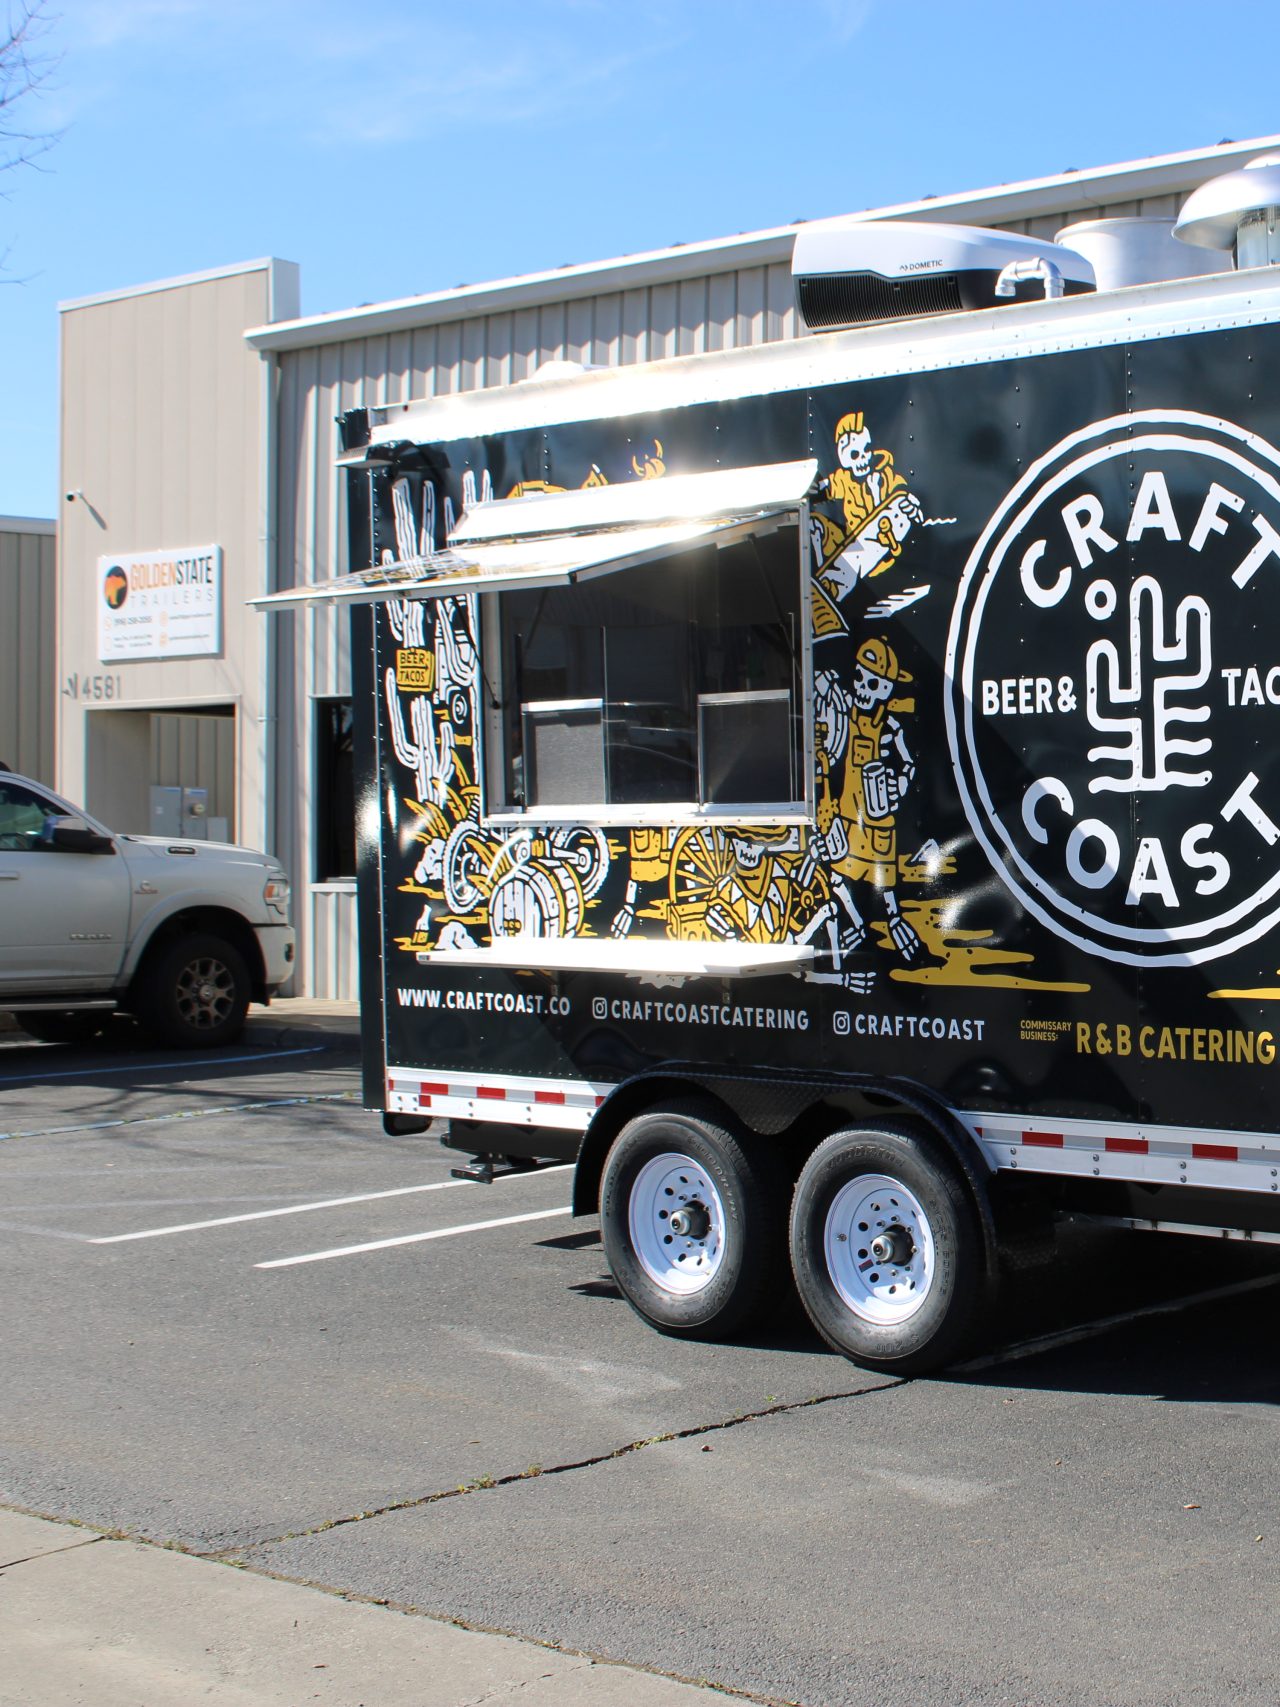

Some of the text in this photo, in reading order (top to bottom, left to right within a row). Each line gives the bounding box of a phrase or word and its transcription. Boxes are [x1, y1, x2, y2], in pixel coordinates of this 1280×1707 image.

[910, 260, 943, 270] DOMETIC
[400, 652, 425, 664] BEER
[82, 675, 121, 699] 4581
[400, 670, 425, 682] TACOS
[982, 675, 1077, 716] BEER&
[397, 988, 571, 1016] WWW.CRAFTCOAST.CO
[611, 1000, 809, 1030] CRAFTCOASTCATERING
[854, 1013, 985, 1041] CRAFTCOAST
[1020, 1020, 1072, 1031] COMMISSARY
[1020, 1030, 1059, 1041] BUSINESS:
[1139, 1026, 1276, 1065] CATERING
